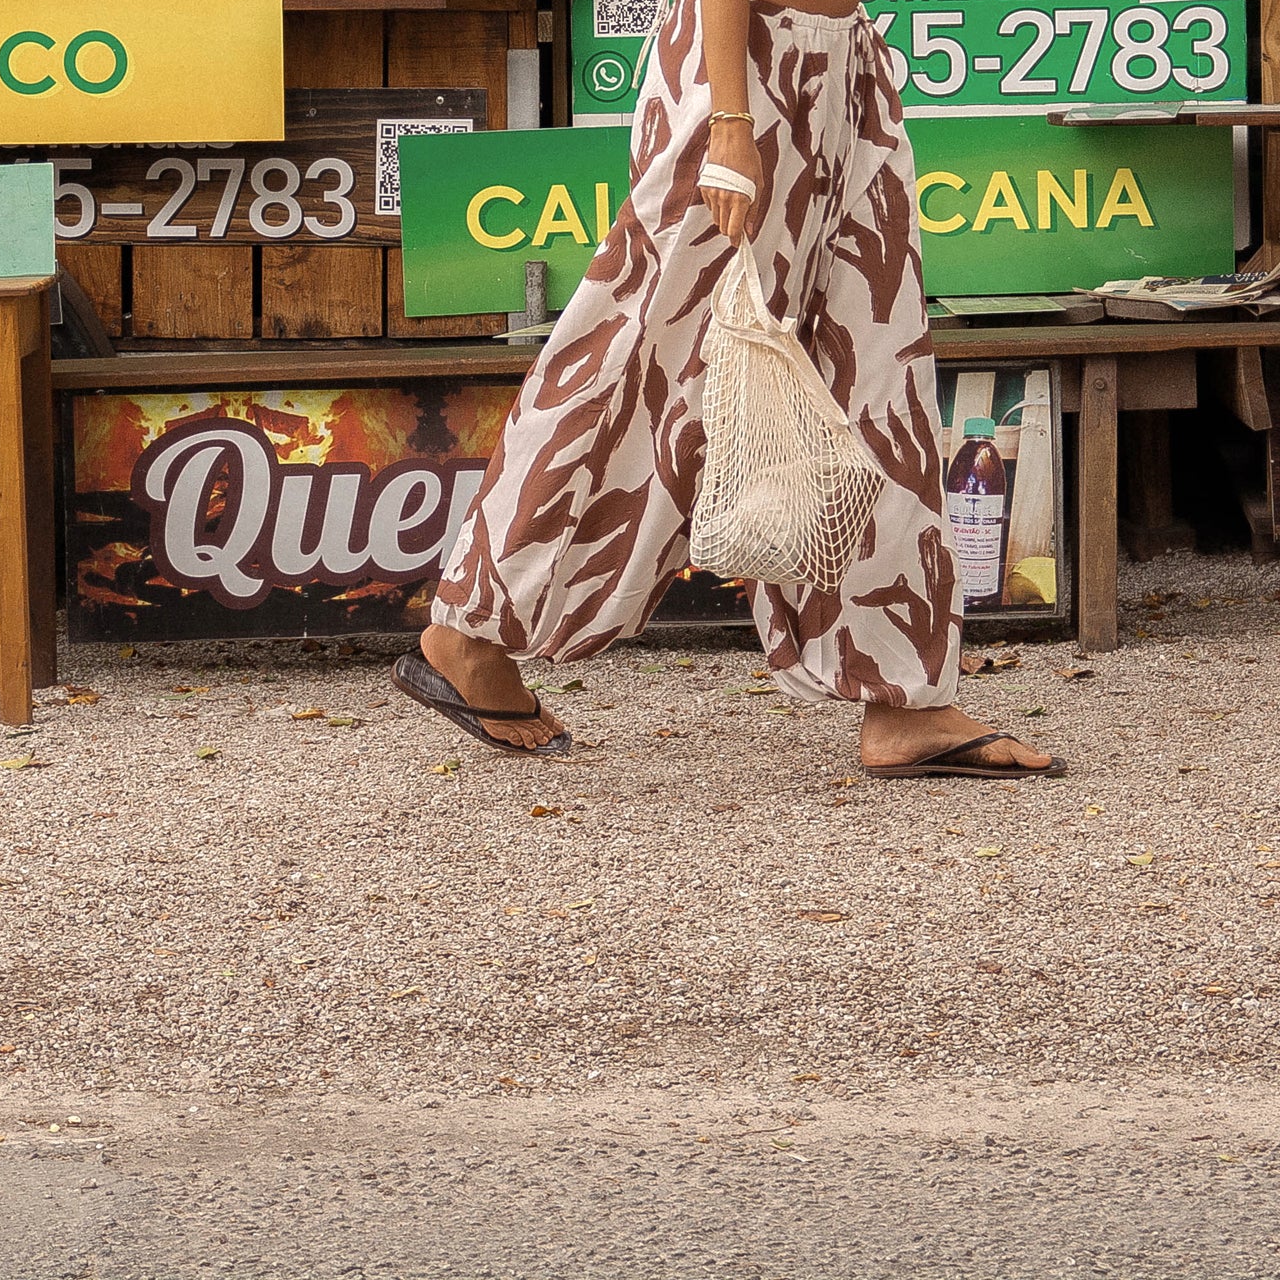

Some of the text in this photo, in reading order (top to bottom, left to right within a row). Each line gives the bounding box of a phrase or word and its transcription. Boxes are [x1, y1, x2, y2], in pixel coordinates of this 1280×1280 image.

[48, 158, 357, 239] 5-2783
[466, 167, 1155, 249] CAL CANA
